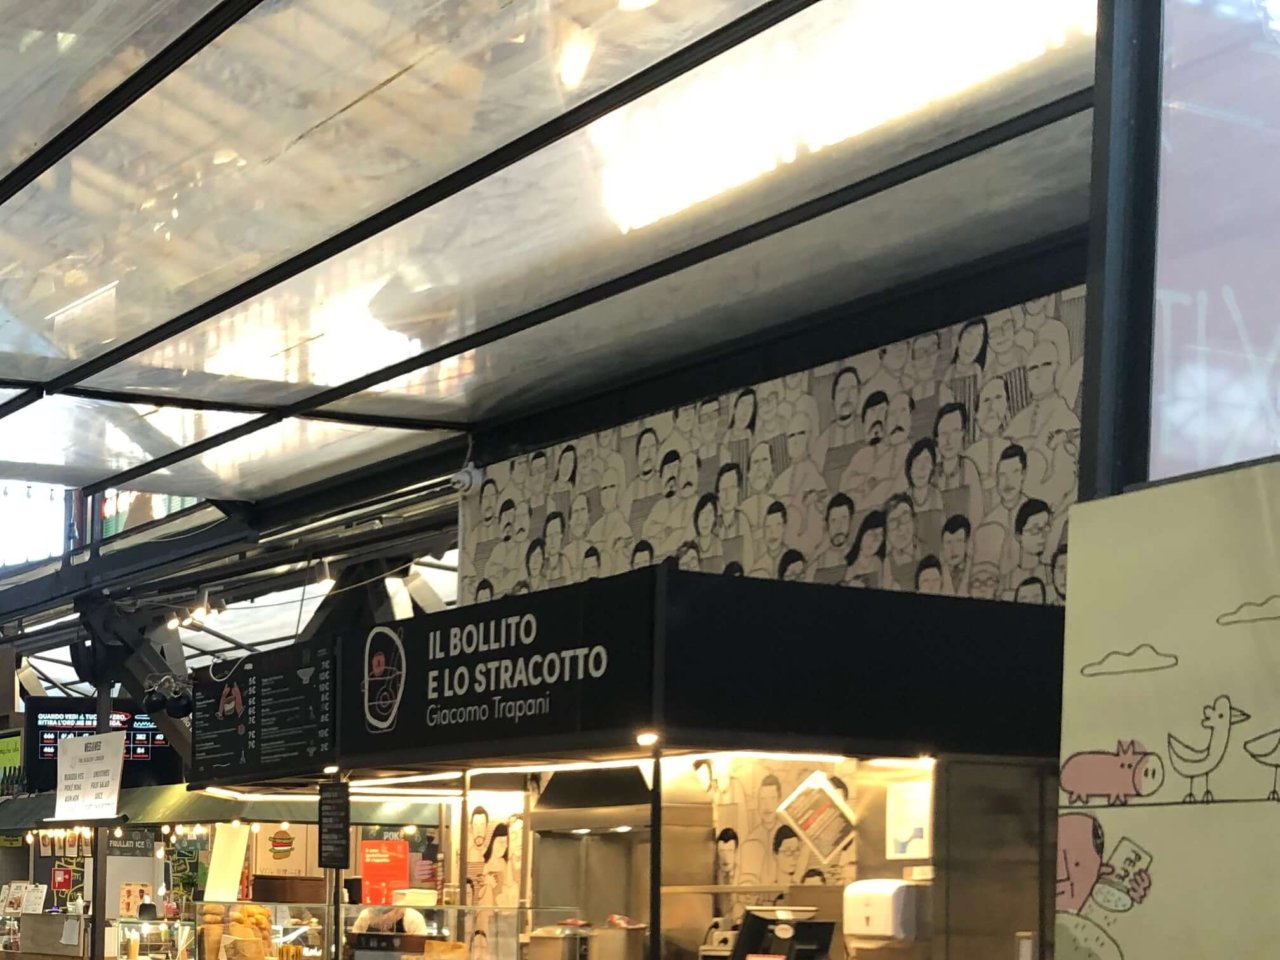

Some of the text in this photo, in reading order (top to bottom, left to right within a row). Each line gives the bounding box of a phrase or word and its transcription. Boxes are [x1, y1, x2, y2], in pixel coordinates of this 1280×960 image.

[428, 613, 537, 660] IL BOLLITO
[427, 645, 608, 699] E LO STRACOTTO
[426, 690, 550, 726] Giacomo Trapani
[135, 840, 145, 849] ICE
